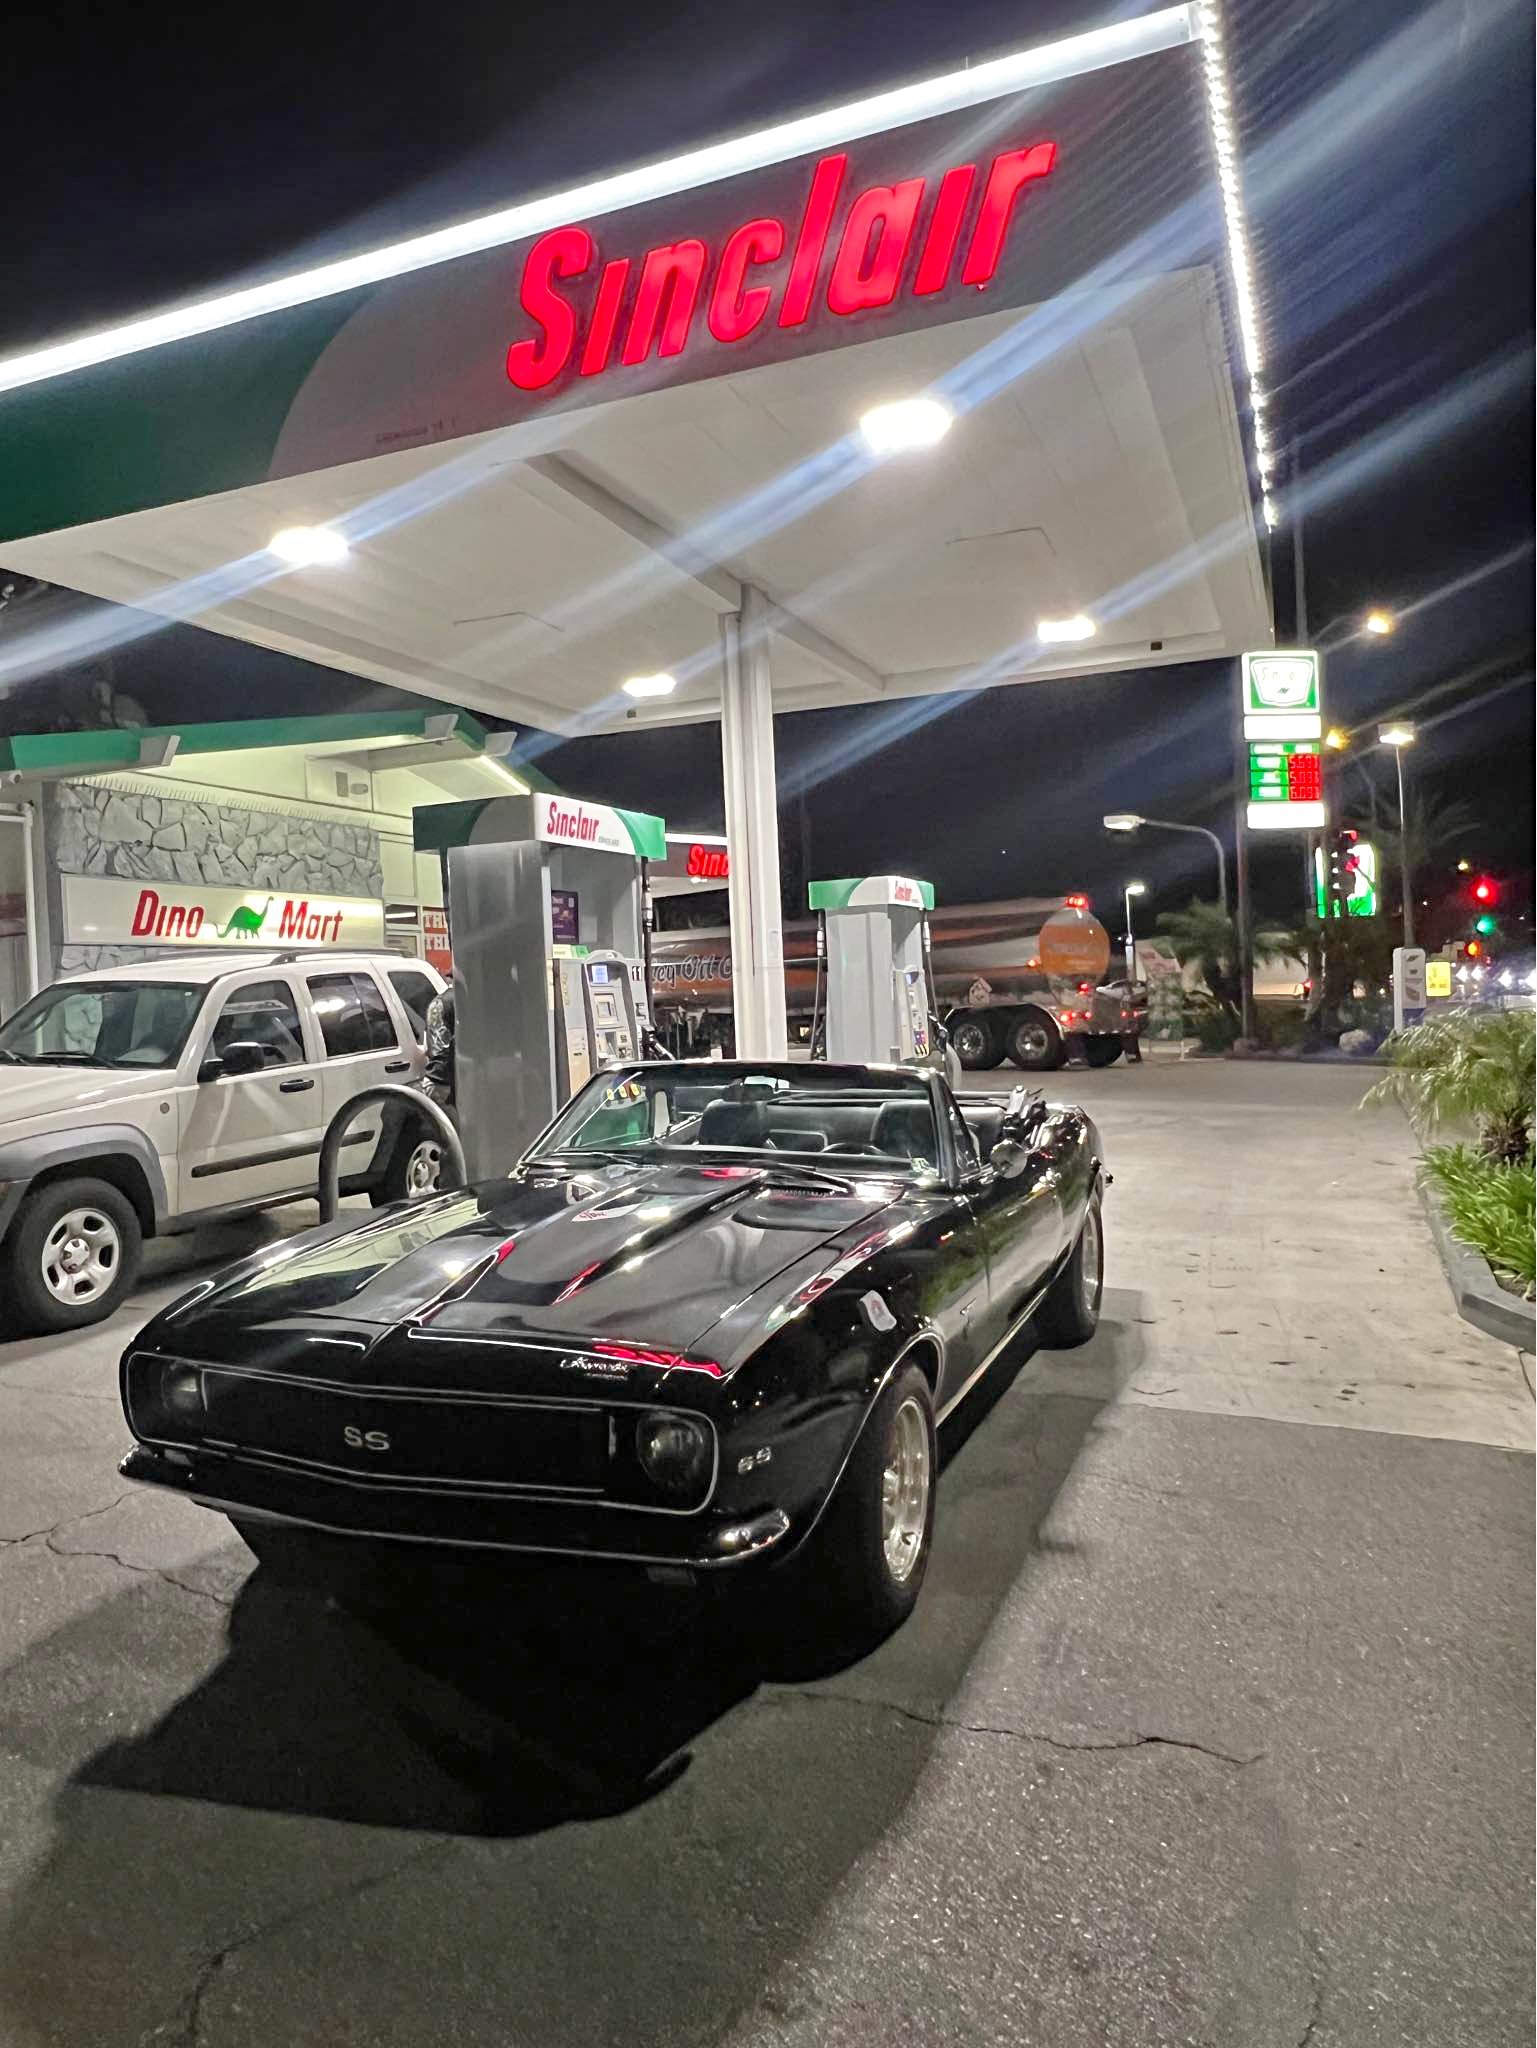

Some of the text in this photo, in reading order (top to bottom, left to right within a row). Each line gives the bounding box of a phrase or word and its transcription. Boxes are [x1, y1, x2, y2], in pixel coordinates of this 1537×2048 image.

[506, 141, 1056, 391] Sinclair
[547, 801, 600, 841] Sinclair
[687, 844, 730, 877] Sinc
[131, 889, 344, 942] Dino Mart
[344, 1426, 390, 1450] SS
